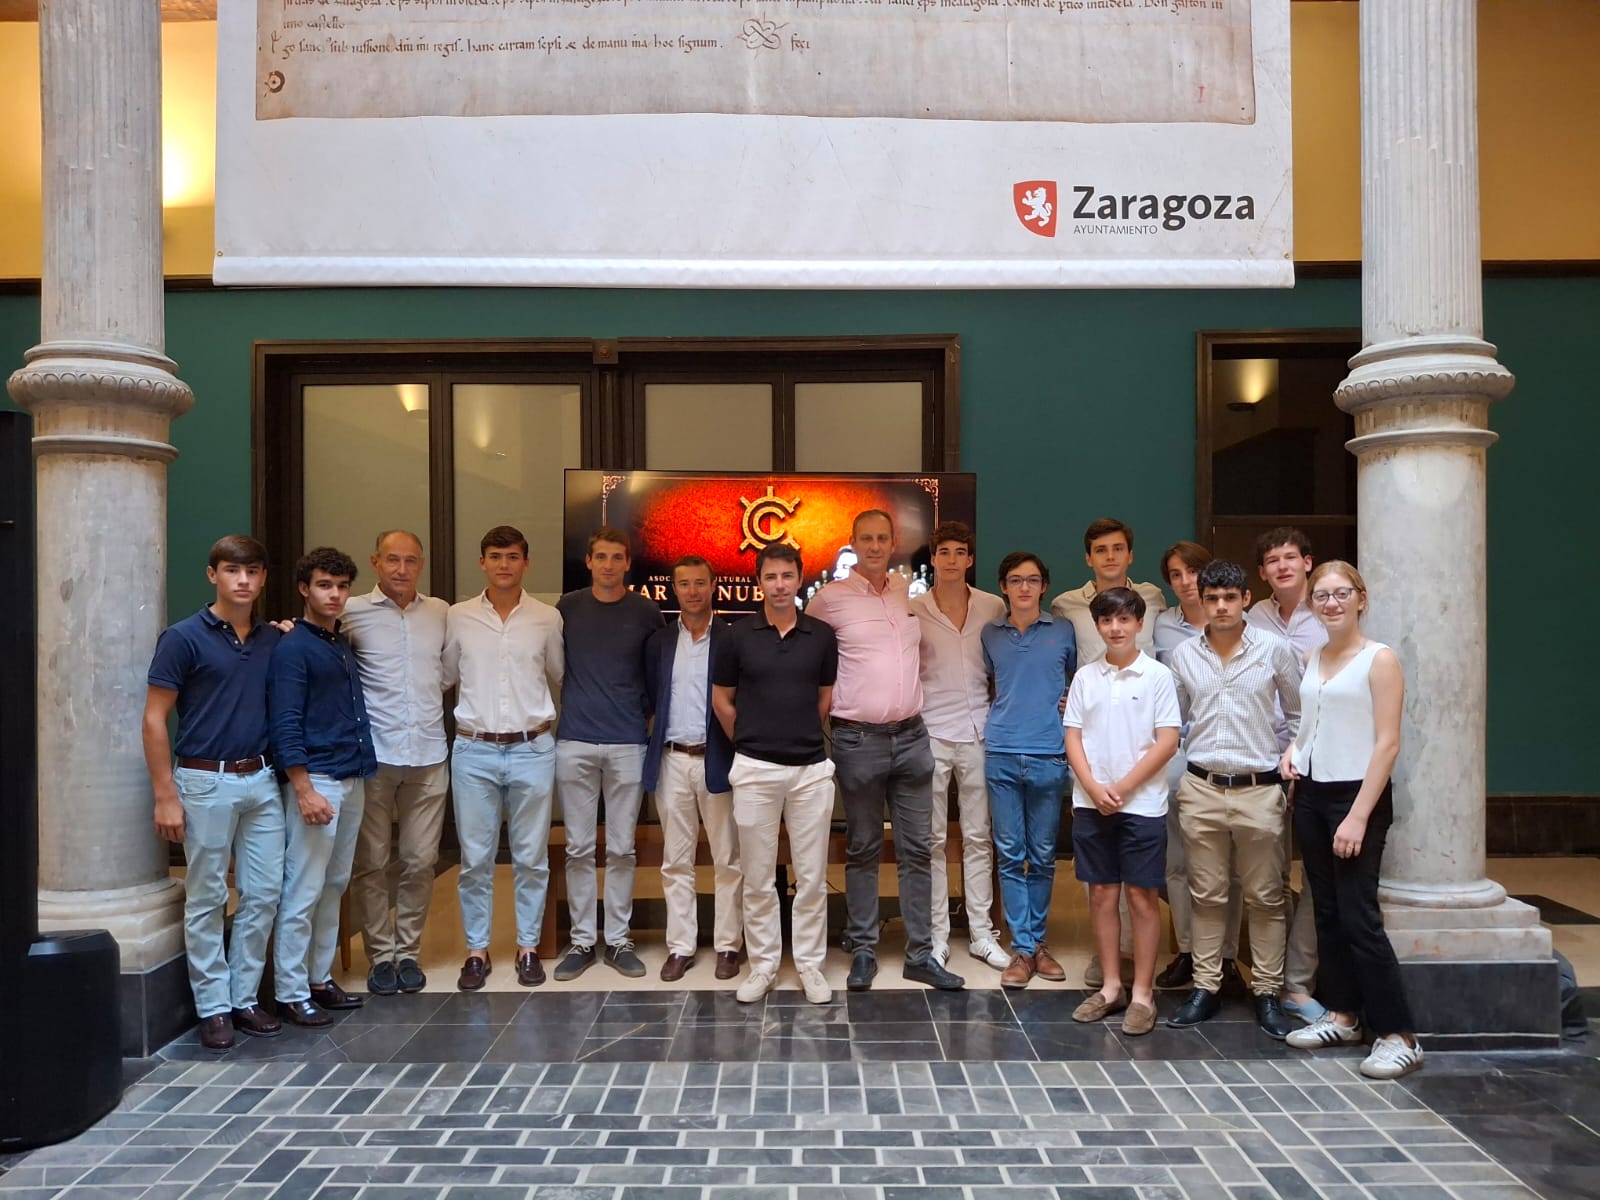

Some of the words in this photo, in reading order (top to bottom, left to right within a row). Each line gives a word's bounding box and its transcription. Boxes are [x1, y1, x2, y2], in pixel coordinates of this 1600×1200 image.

[1073, 185, 1255, 231] Zaragoza
[1073, 224, 1158, 235] AYUNTAMIENTO
[717, 585, 766, 602] NUB
